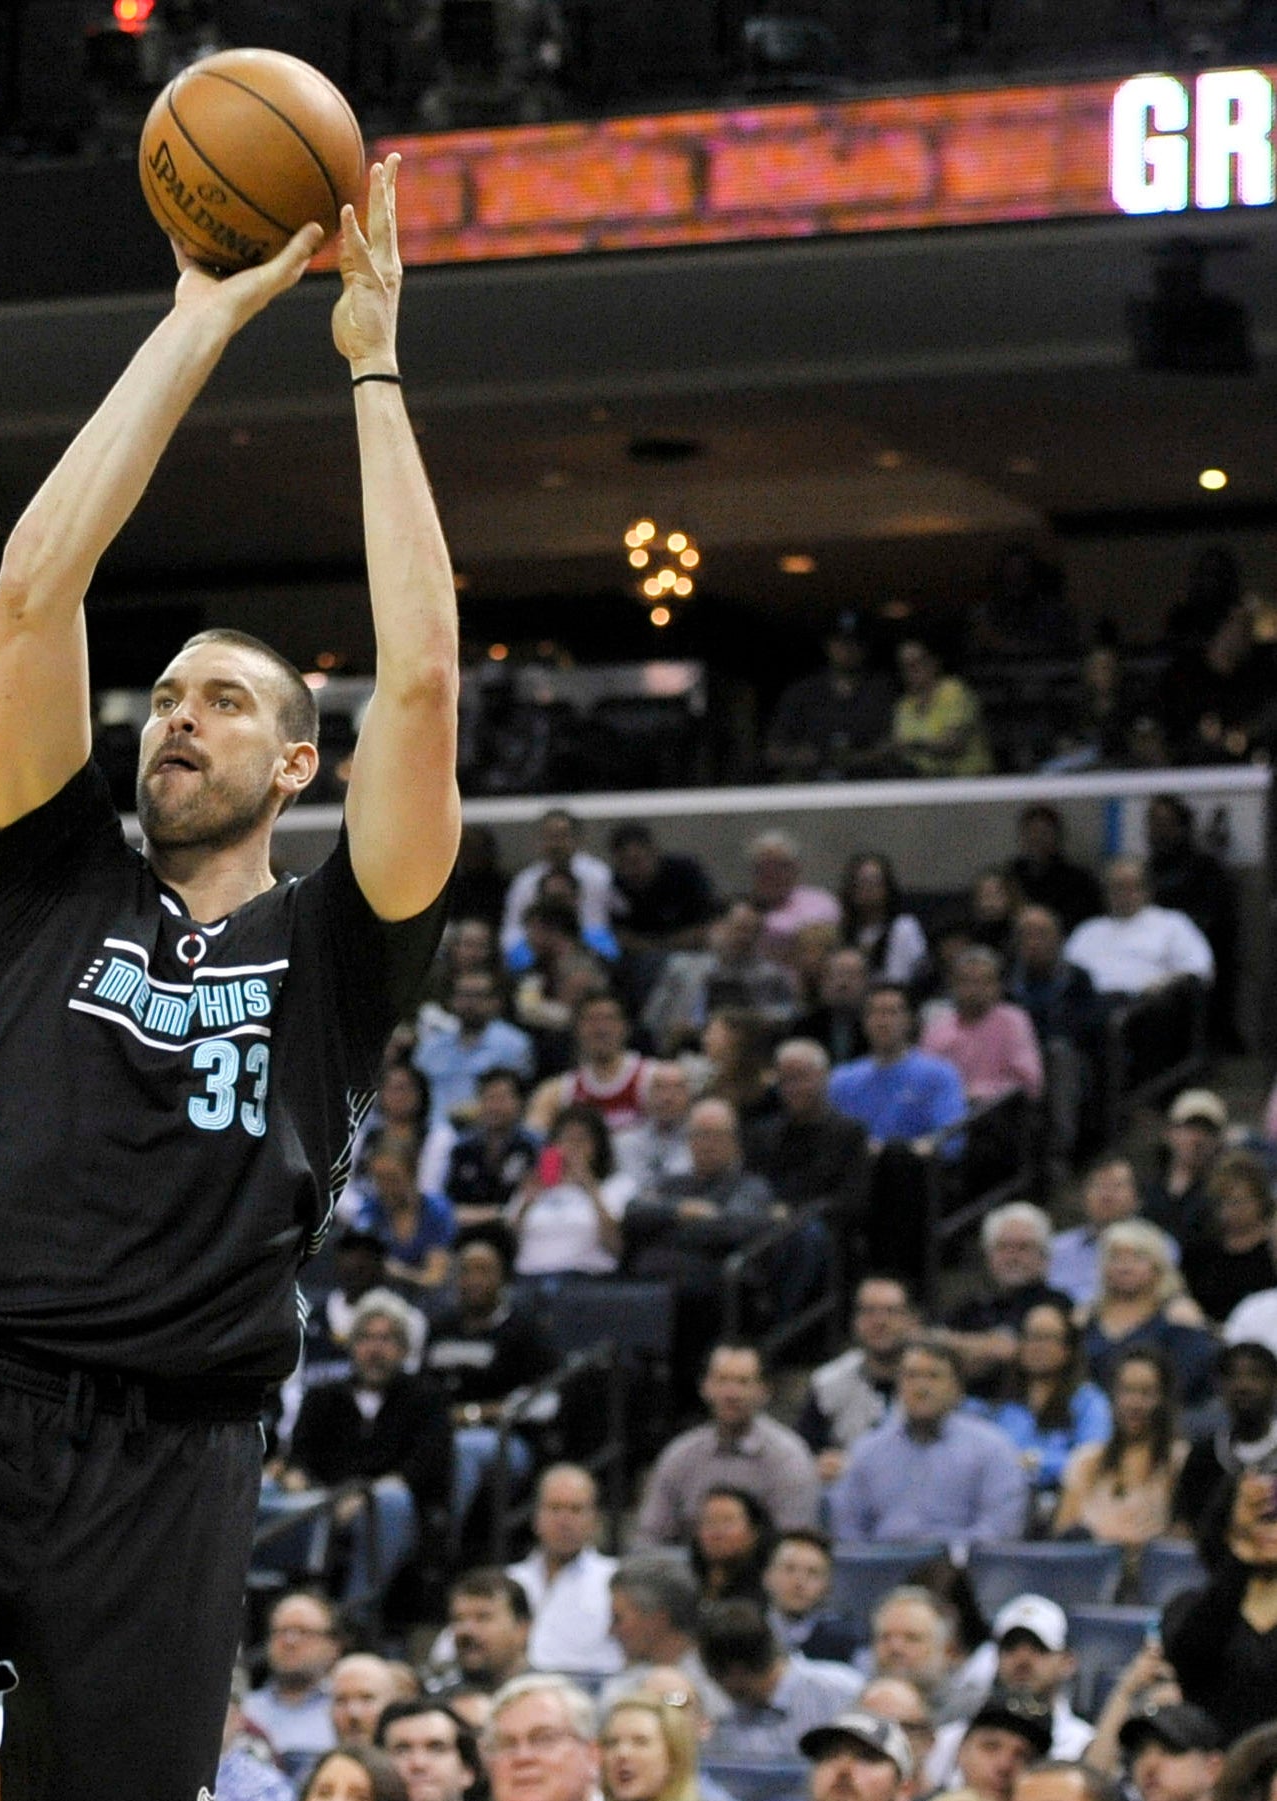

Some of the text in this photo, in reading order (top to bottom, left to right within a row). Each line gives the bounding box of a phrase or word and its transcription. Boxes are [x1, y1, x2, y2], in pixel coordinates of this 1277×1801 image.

[1110, 69, 1276, 215] GR
[93, 957, 271, 1037] MEMPHIS
[188, 1040, 270, 1137] 33
